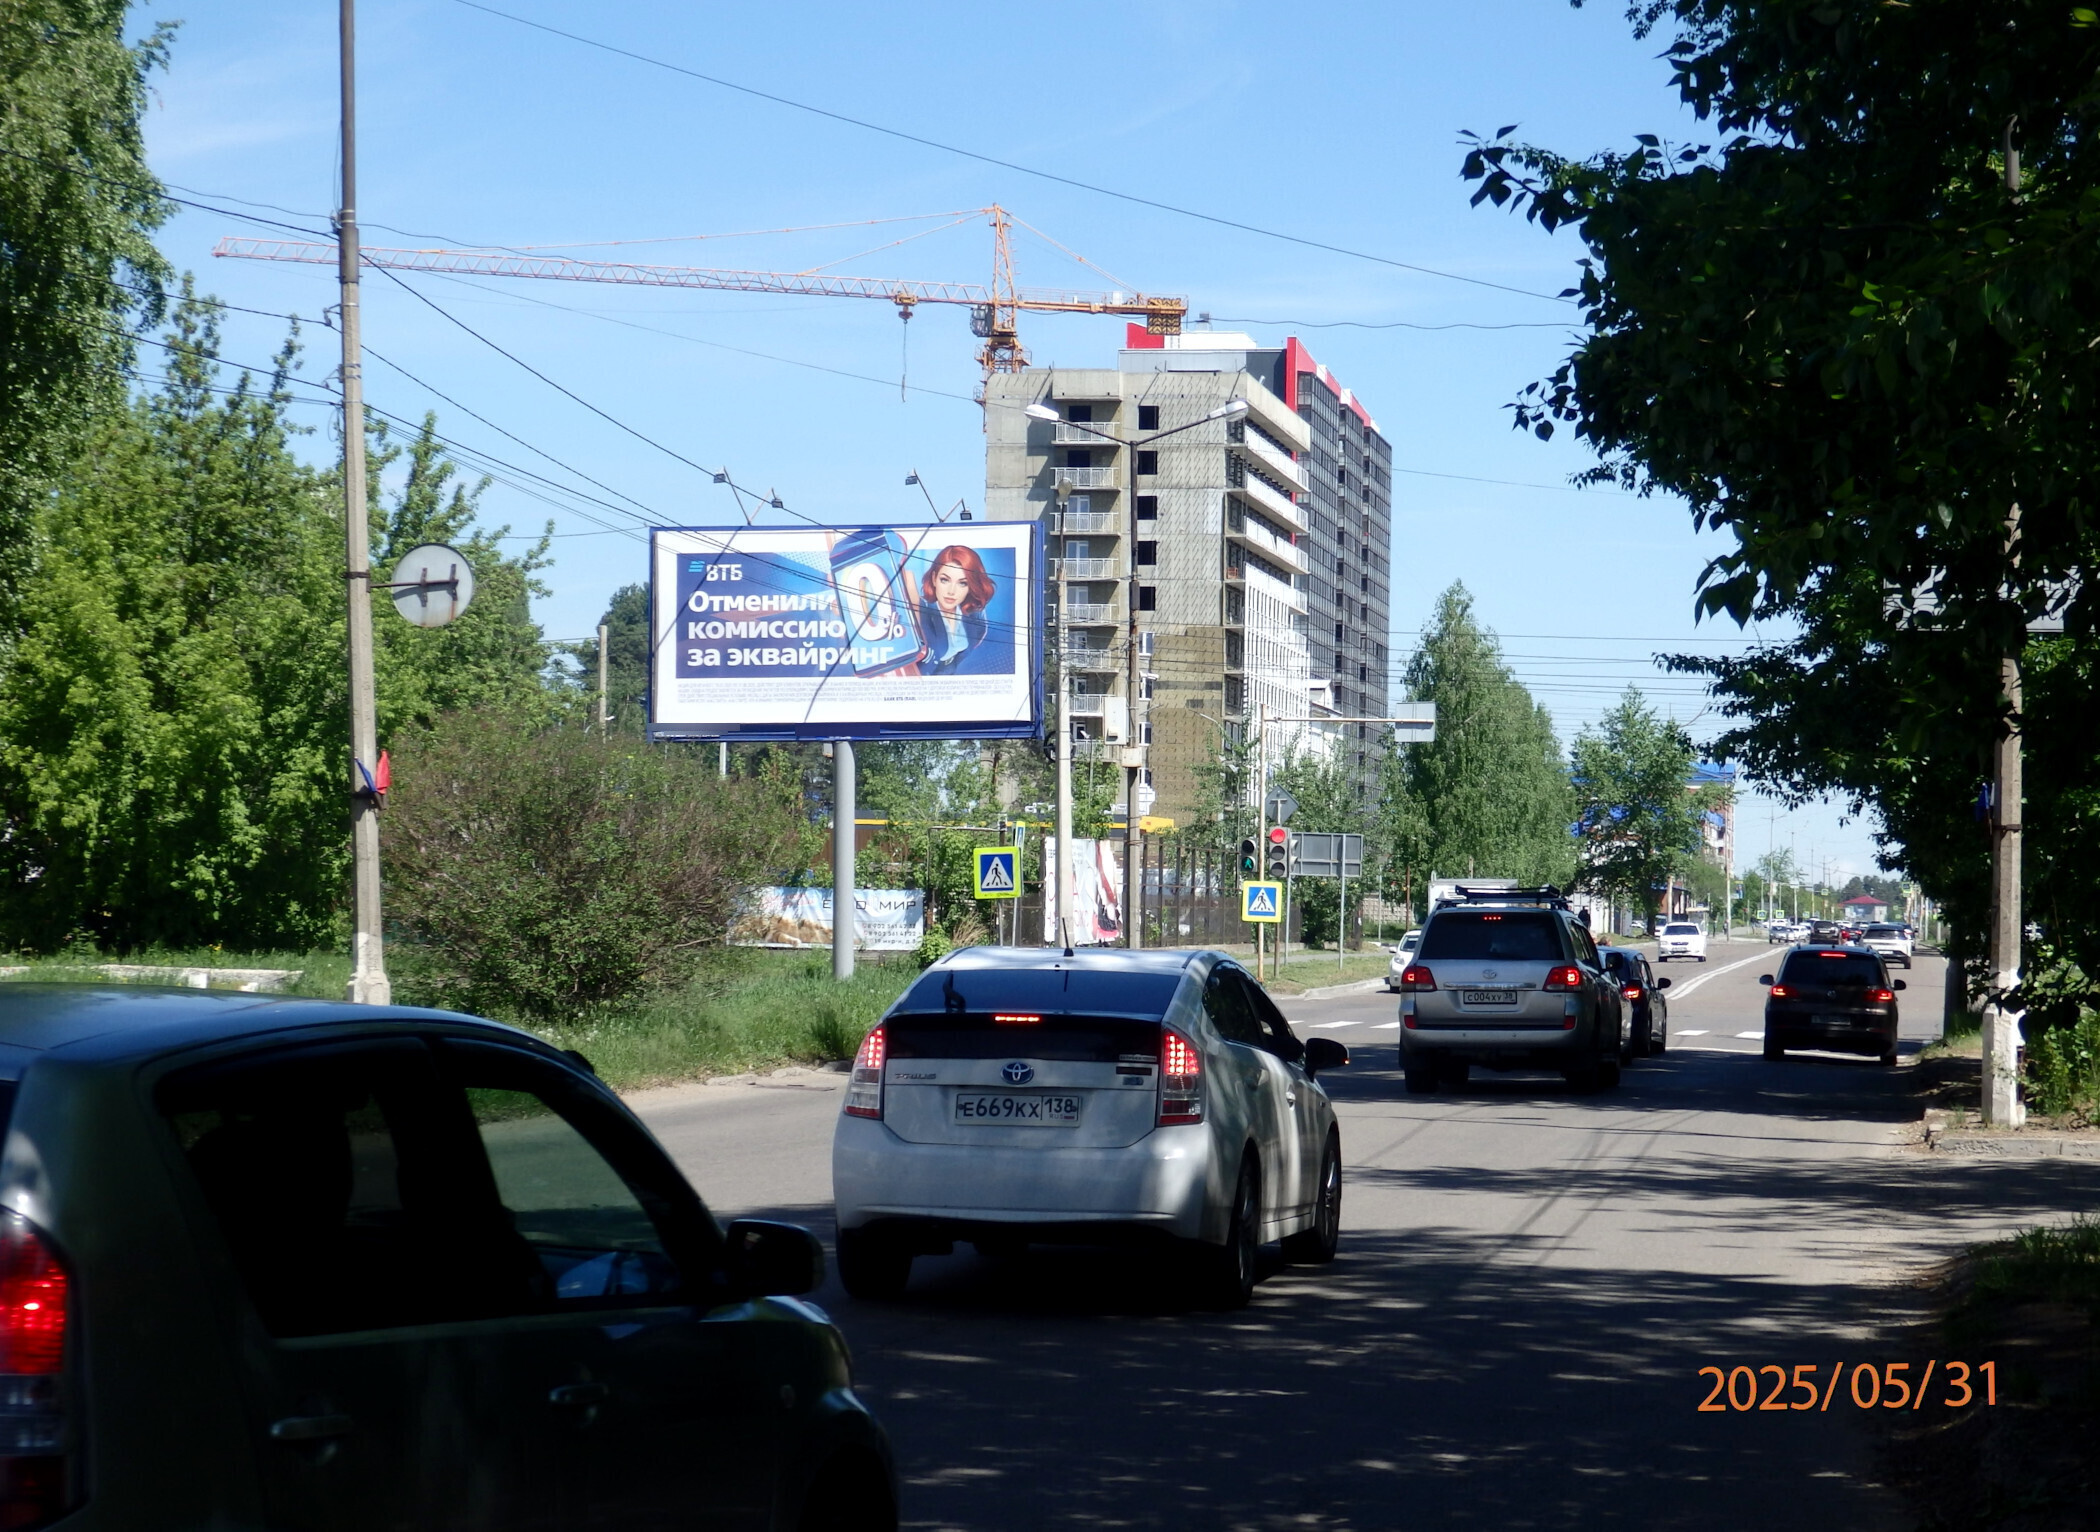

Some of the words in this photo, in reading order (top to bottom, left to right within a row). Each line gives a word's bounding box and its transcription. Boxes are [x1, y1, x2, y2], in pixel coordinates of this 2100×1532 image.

[706, 563, 743, 582] ВТБ
[688, 590, 837, 613] Отменили
[688, 619, 846, 640] комиссию
[687, 648, 721, 667] за
[727, 641, 893, 671] эквайринг
[879, 900, 917, 910] МИР
[963, 1097, 1040, 1118] Е669КХ
[1044, 1098, 1074, 1113] 138
